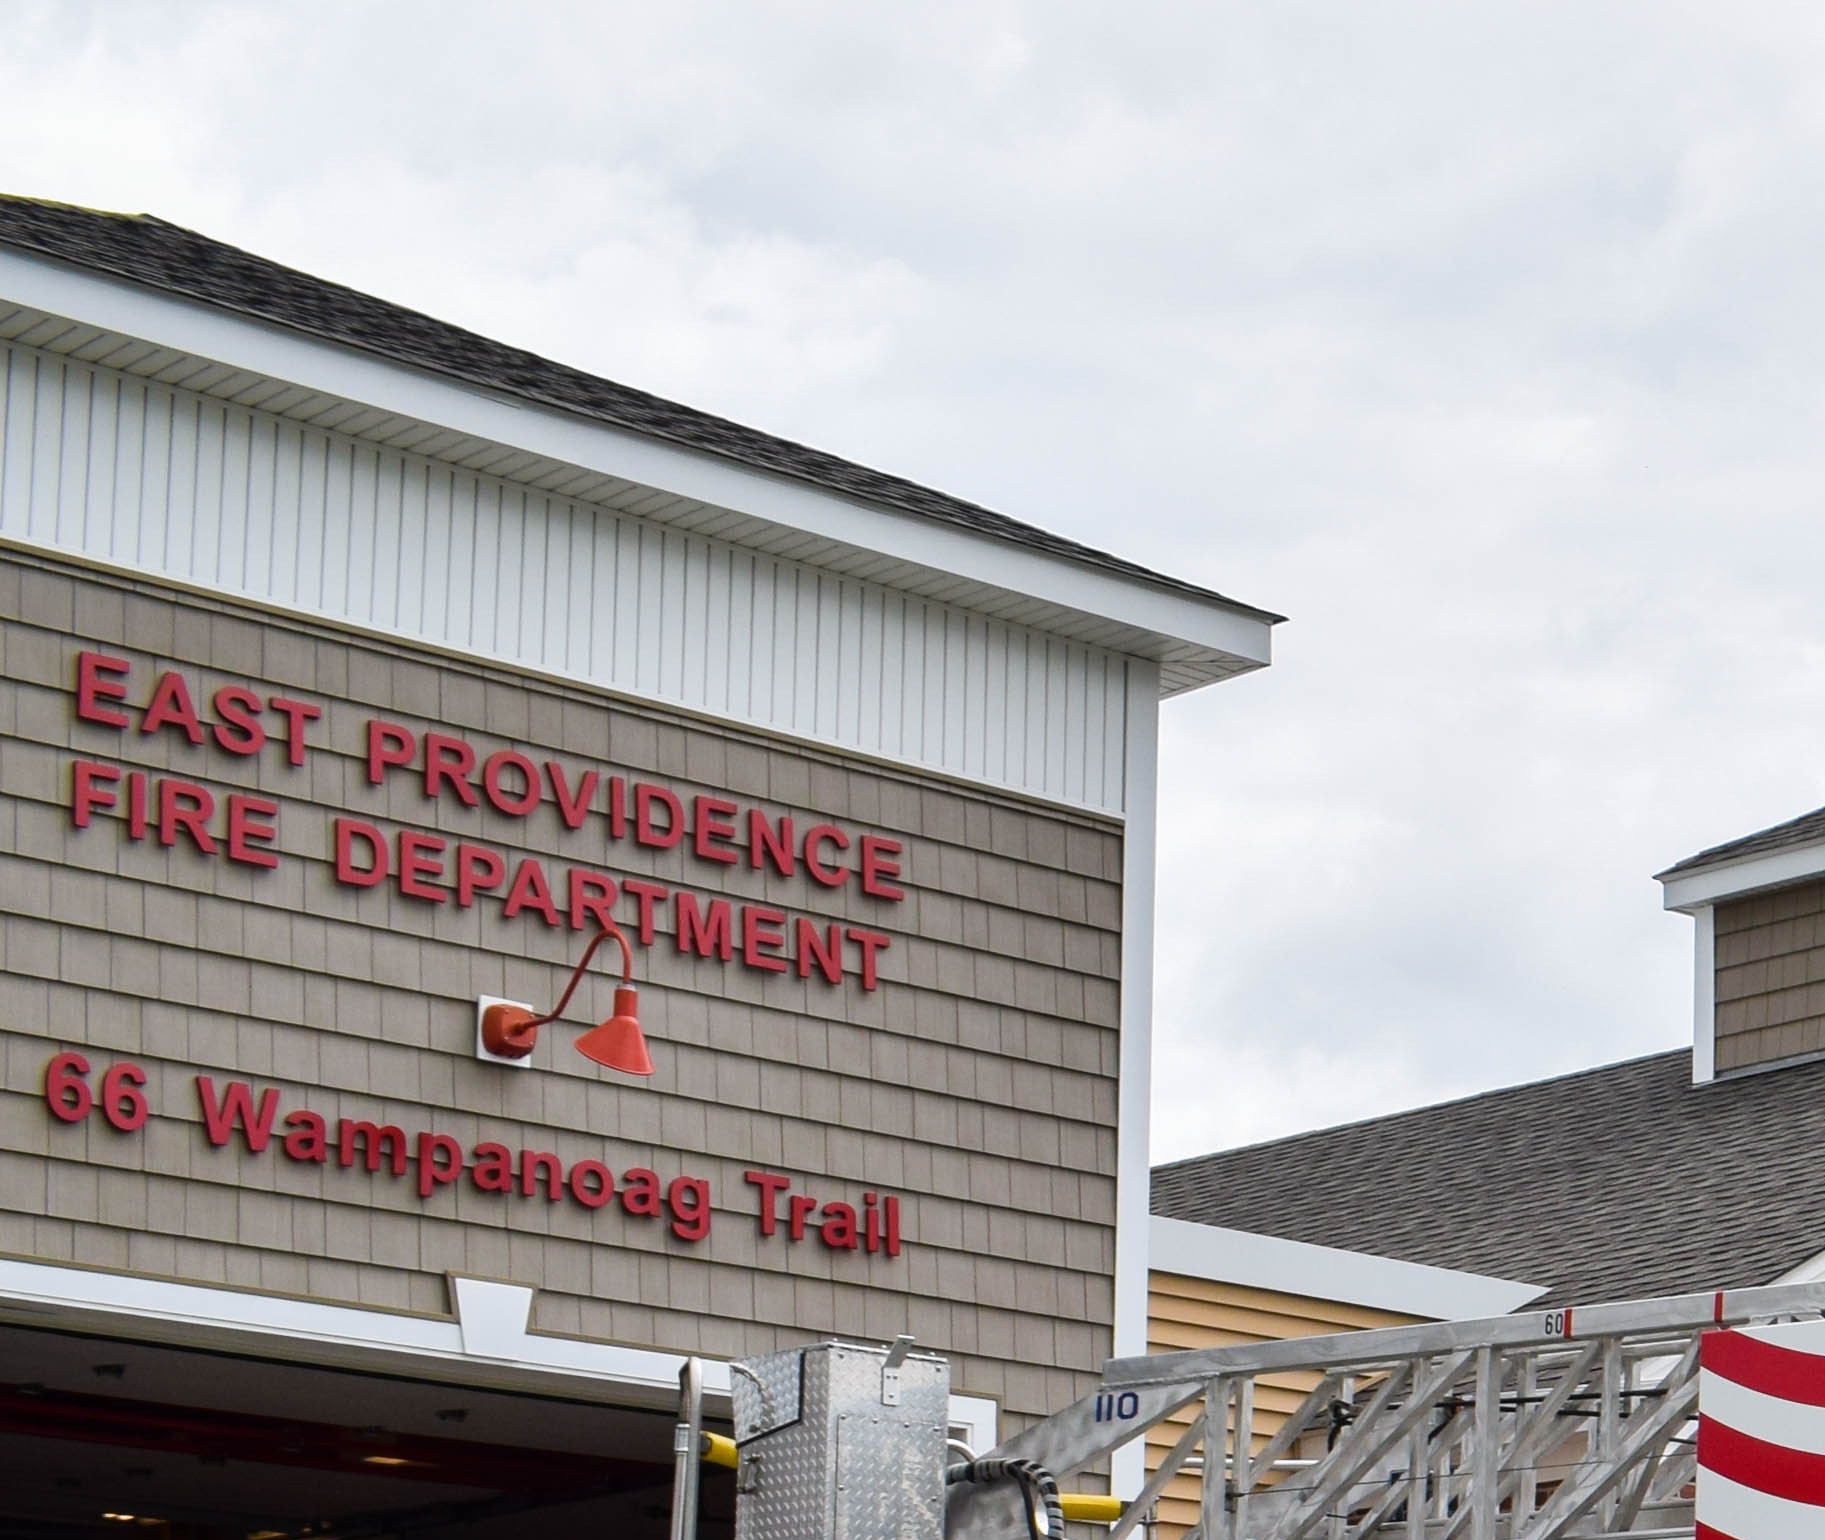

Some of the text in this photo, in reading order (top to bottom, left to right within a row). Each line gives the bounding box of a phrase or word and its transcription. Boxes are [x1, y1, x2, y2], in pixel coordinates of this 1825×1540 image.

[72, 760, 891, 991] FIRE DEPARTMENT
[76, 651, 905, 902] EAST PROVIDENCE
[45, 1052, 901, 1257] 66 Wampanoag Trail
[1095, 1392, 1139, 1422] 110
[1544, 1312, 1564, 1336] 60
